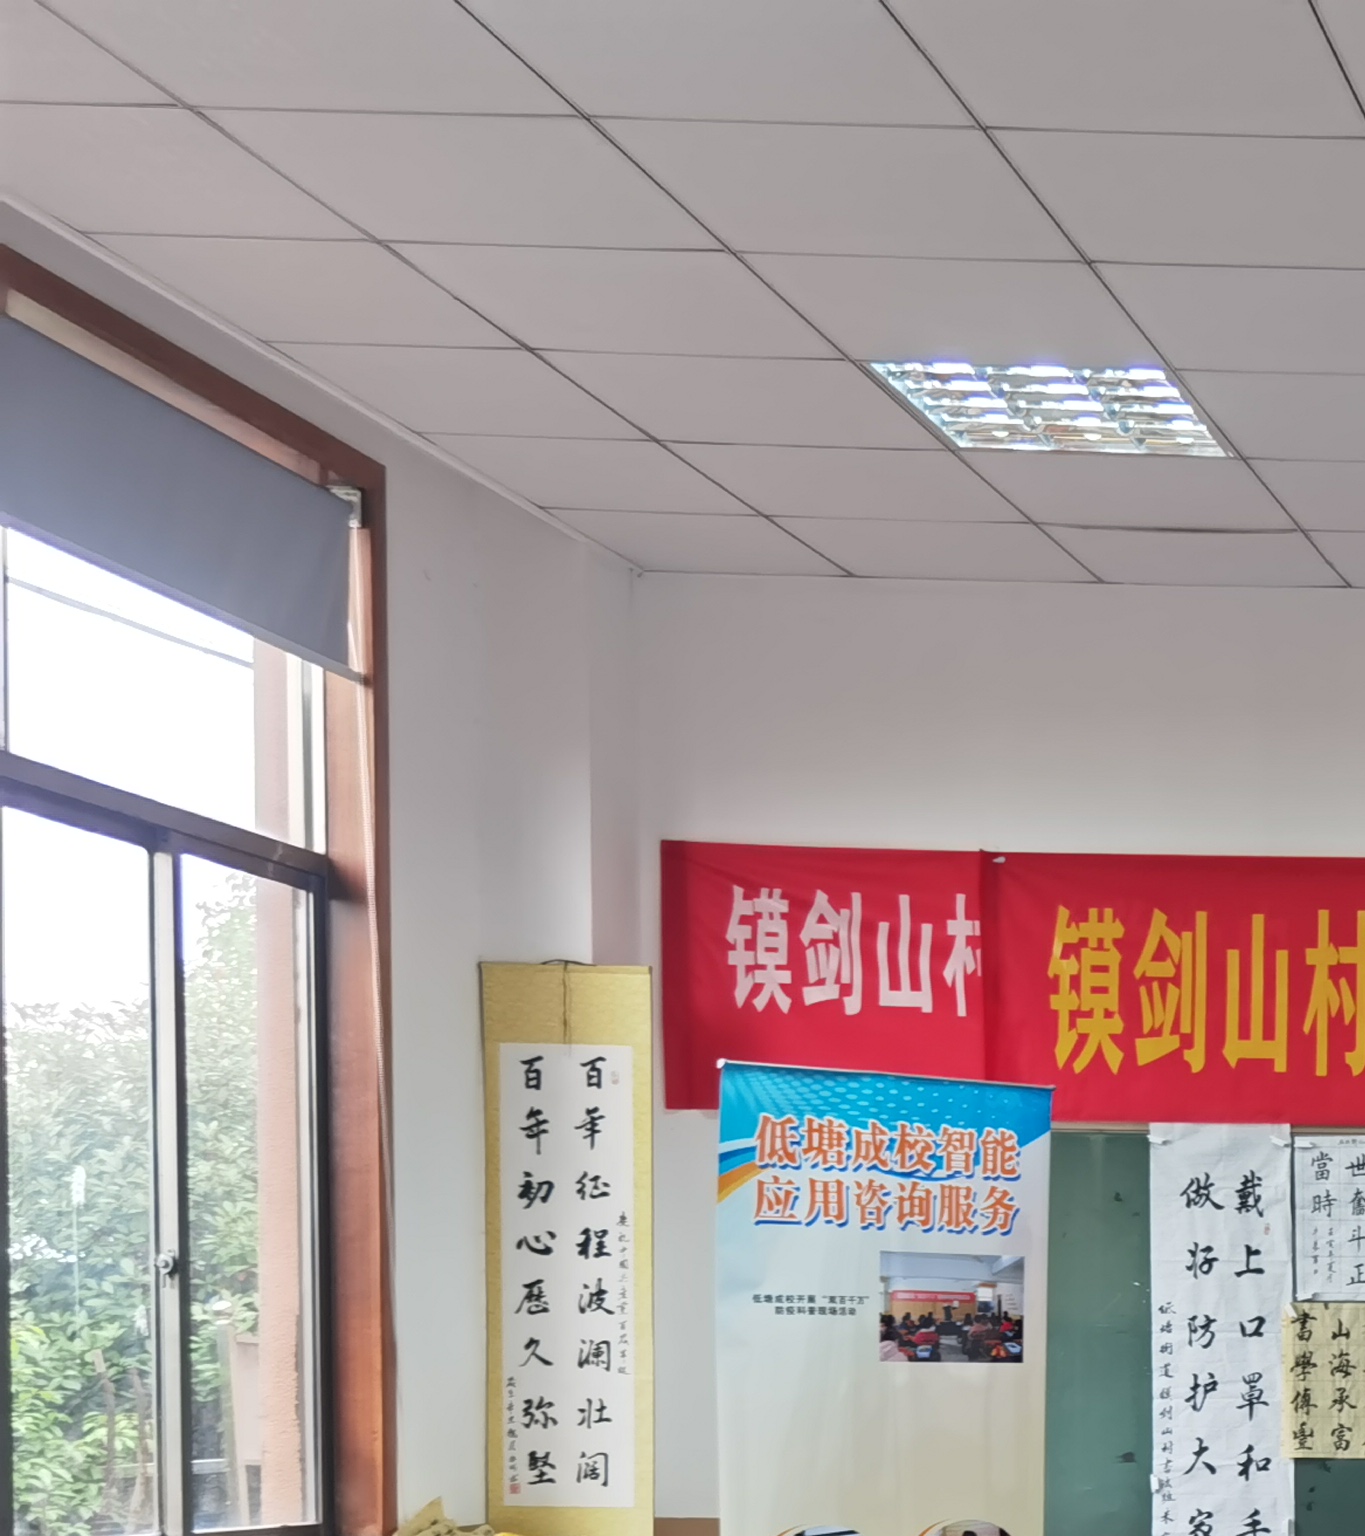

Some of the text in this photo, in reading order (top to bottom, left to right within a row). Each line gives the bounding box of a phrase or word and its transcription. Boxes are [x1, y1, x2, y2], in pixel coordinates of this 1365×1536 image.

[755, 1114, 1020, 1180] 低塘成校智能
[753, 1174, 1019, 1234] 应用咨询服务
